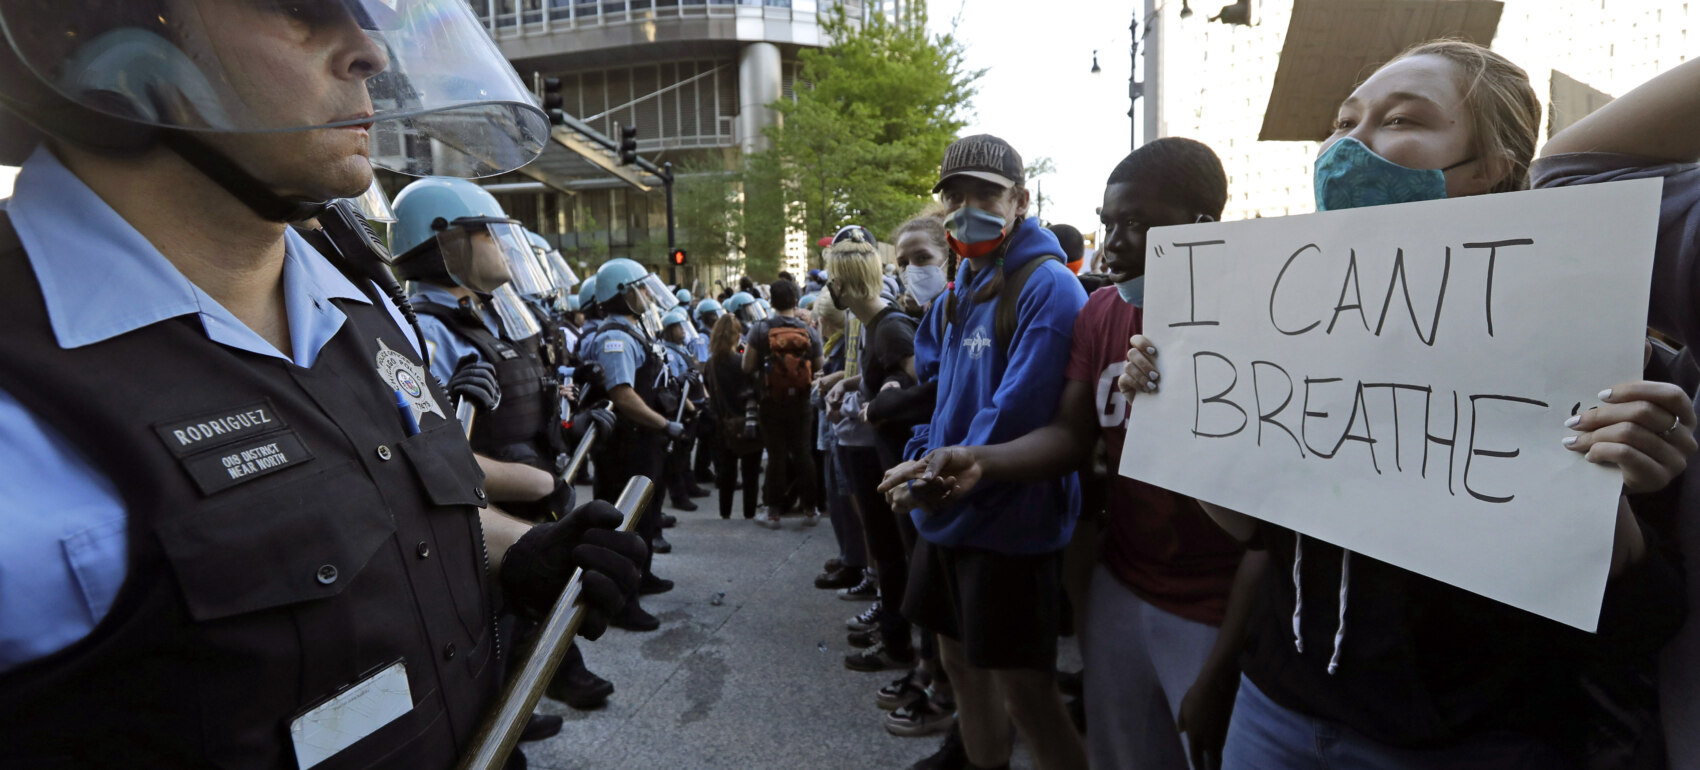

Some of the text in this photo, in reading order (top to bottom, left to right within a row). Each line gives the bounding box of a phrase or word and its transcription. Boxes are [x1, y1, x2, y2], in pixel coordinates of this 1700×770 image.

[980, 141, 1006, 171] SOX
[1269, 238, 1534, 347] CANT
[385, 357, 426, 391] CHICAGO POLICE
[173, 409, 272, 446] RODRIGUEZ
[221, 443, 280, 468] 018 DISTRICT
[227, 452, 288, 479] NEAR NORTH
